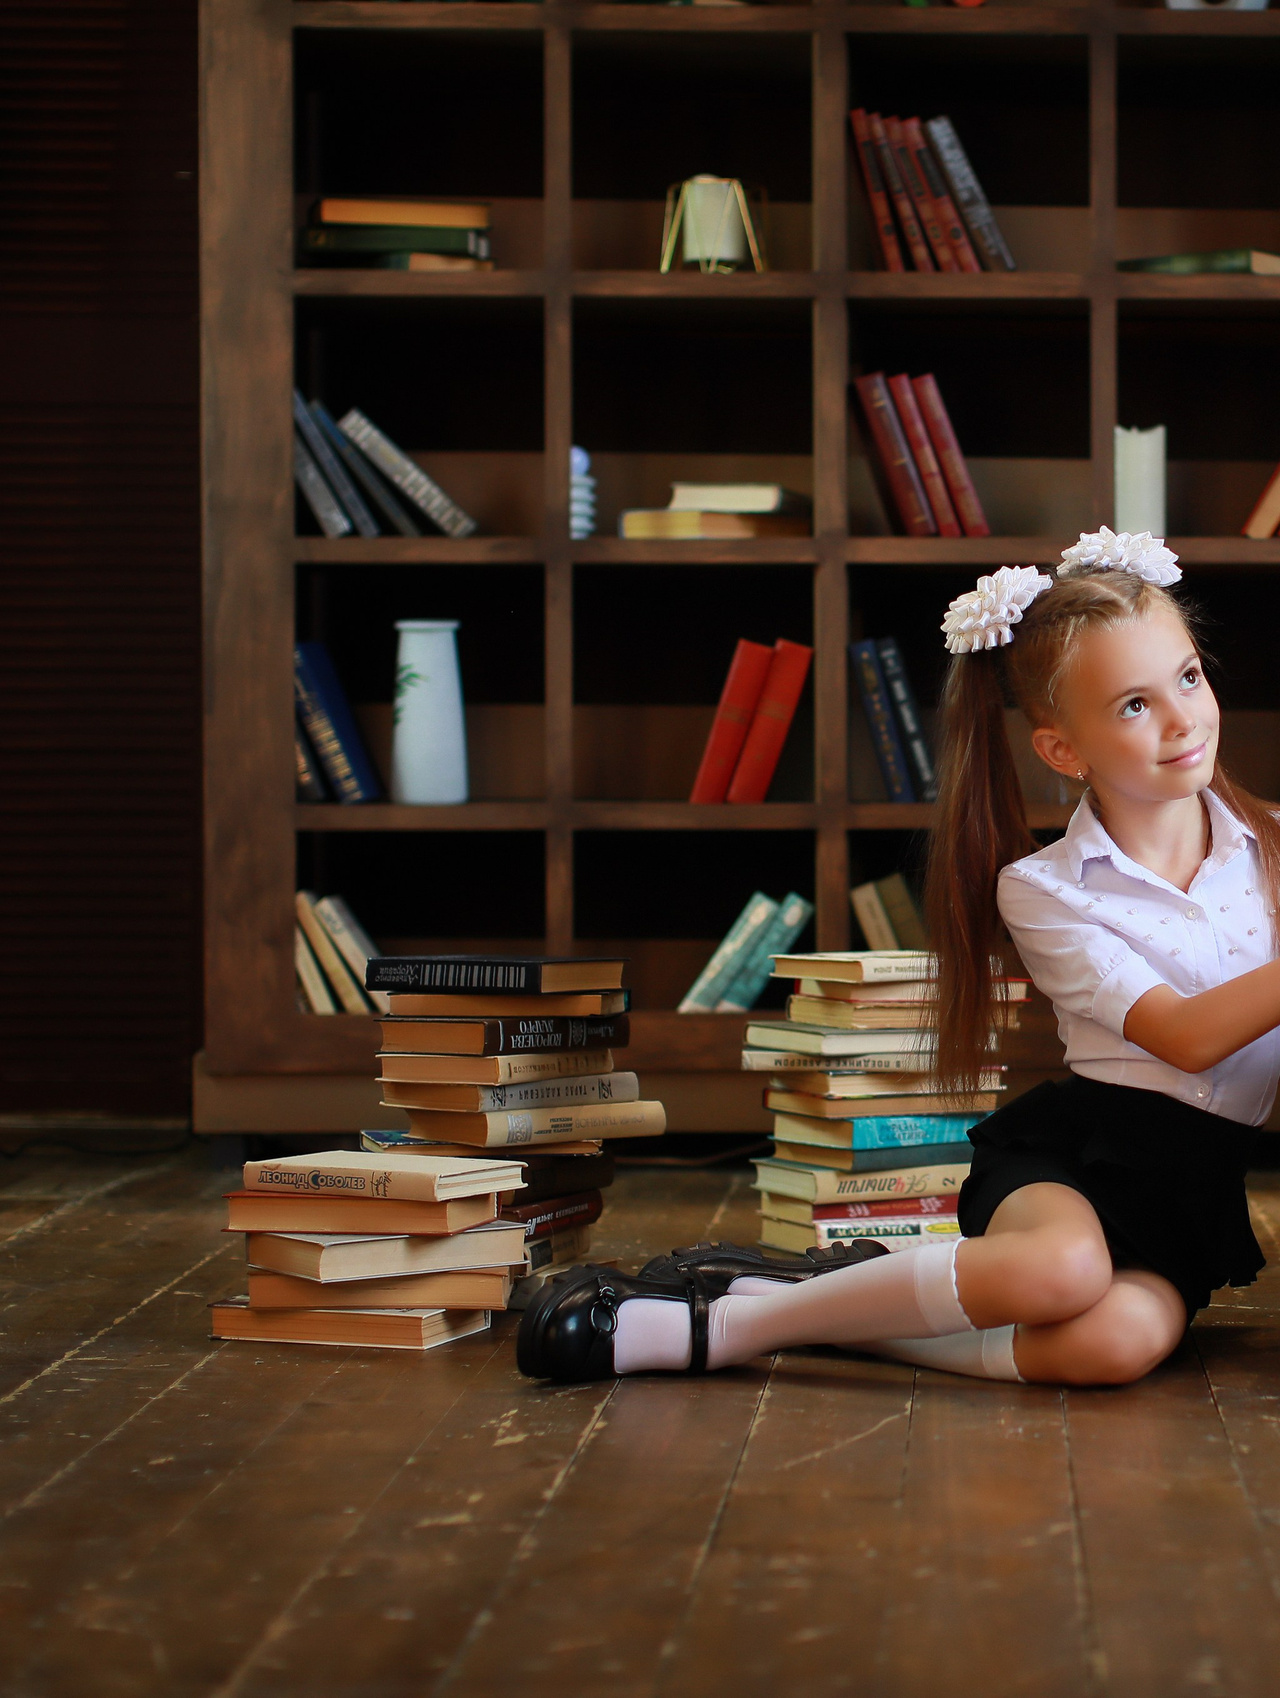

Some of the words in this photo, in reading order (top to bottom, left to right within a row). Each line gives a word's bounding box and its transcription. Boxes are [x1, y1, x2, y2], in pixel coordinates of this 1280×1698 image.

[519, 1019, 554, 1035] МАРГО
[510, 1032, 563, 1049] КОРОЛЕВА
[773, 1058, 822, 1068] АБВЕРОМ
[836, 1058, 890, 1069] ПОЕДИНКЕ
[895, 1060, 902, 1069] В
[564, 1085, 588, 1098] ТАРАС
[257, 1170, 310, 1190] ЛЕОНИД
